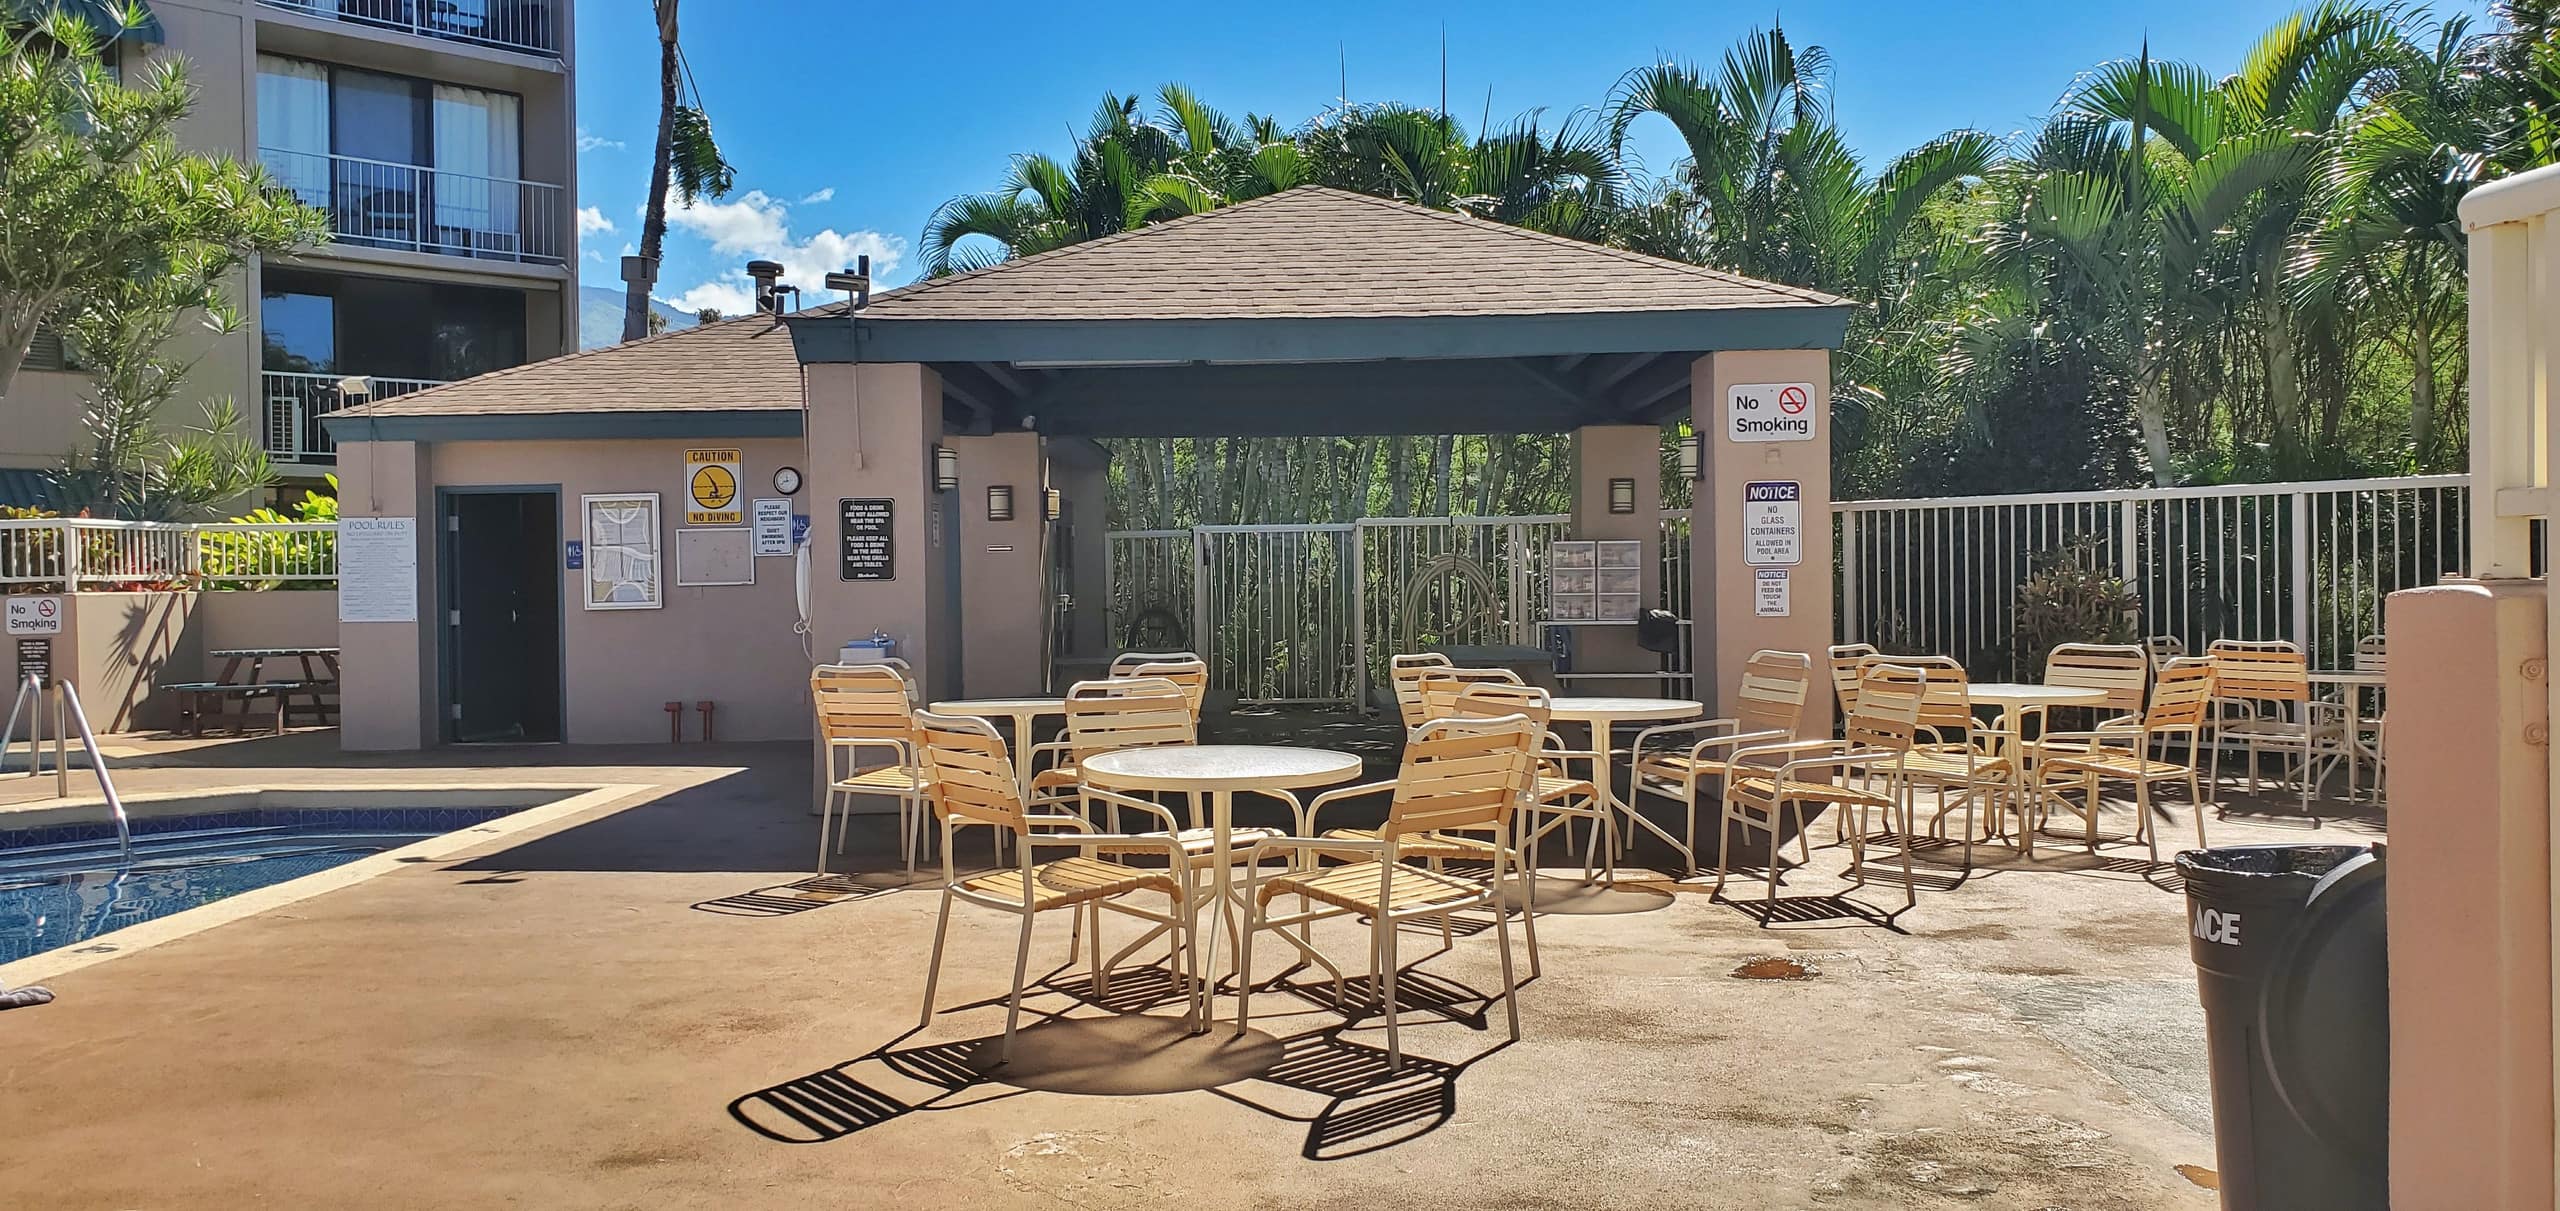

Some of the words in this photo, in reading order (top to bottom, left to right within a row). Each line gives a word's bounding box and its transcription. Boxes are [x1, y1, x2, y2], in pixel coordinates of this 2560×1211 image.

[1736, 395, 1759, 410] No
[1736, 416, 1808, 435] Smoking
[692, 451, 734, 462] CAUTION
[1750, 486, 1796, 500] NOTICE
[1767, 505, 1778, 514] NO
[693, 513, 704, 521] NO
[708, 512, 735, 521] DIVING
[1761, 516, 1785, 525] GLASS
[349, 521, 374, 529] POOL
[378, 521, 405, 529] RULES
[1750, 527, 1796, 536] CONTAINERS
[11, 605, 26, 615] No
[11, 618, 57, 630] Smoking
[2193, 903, 2241, 946] ACE
